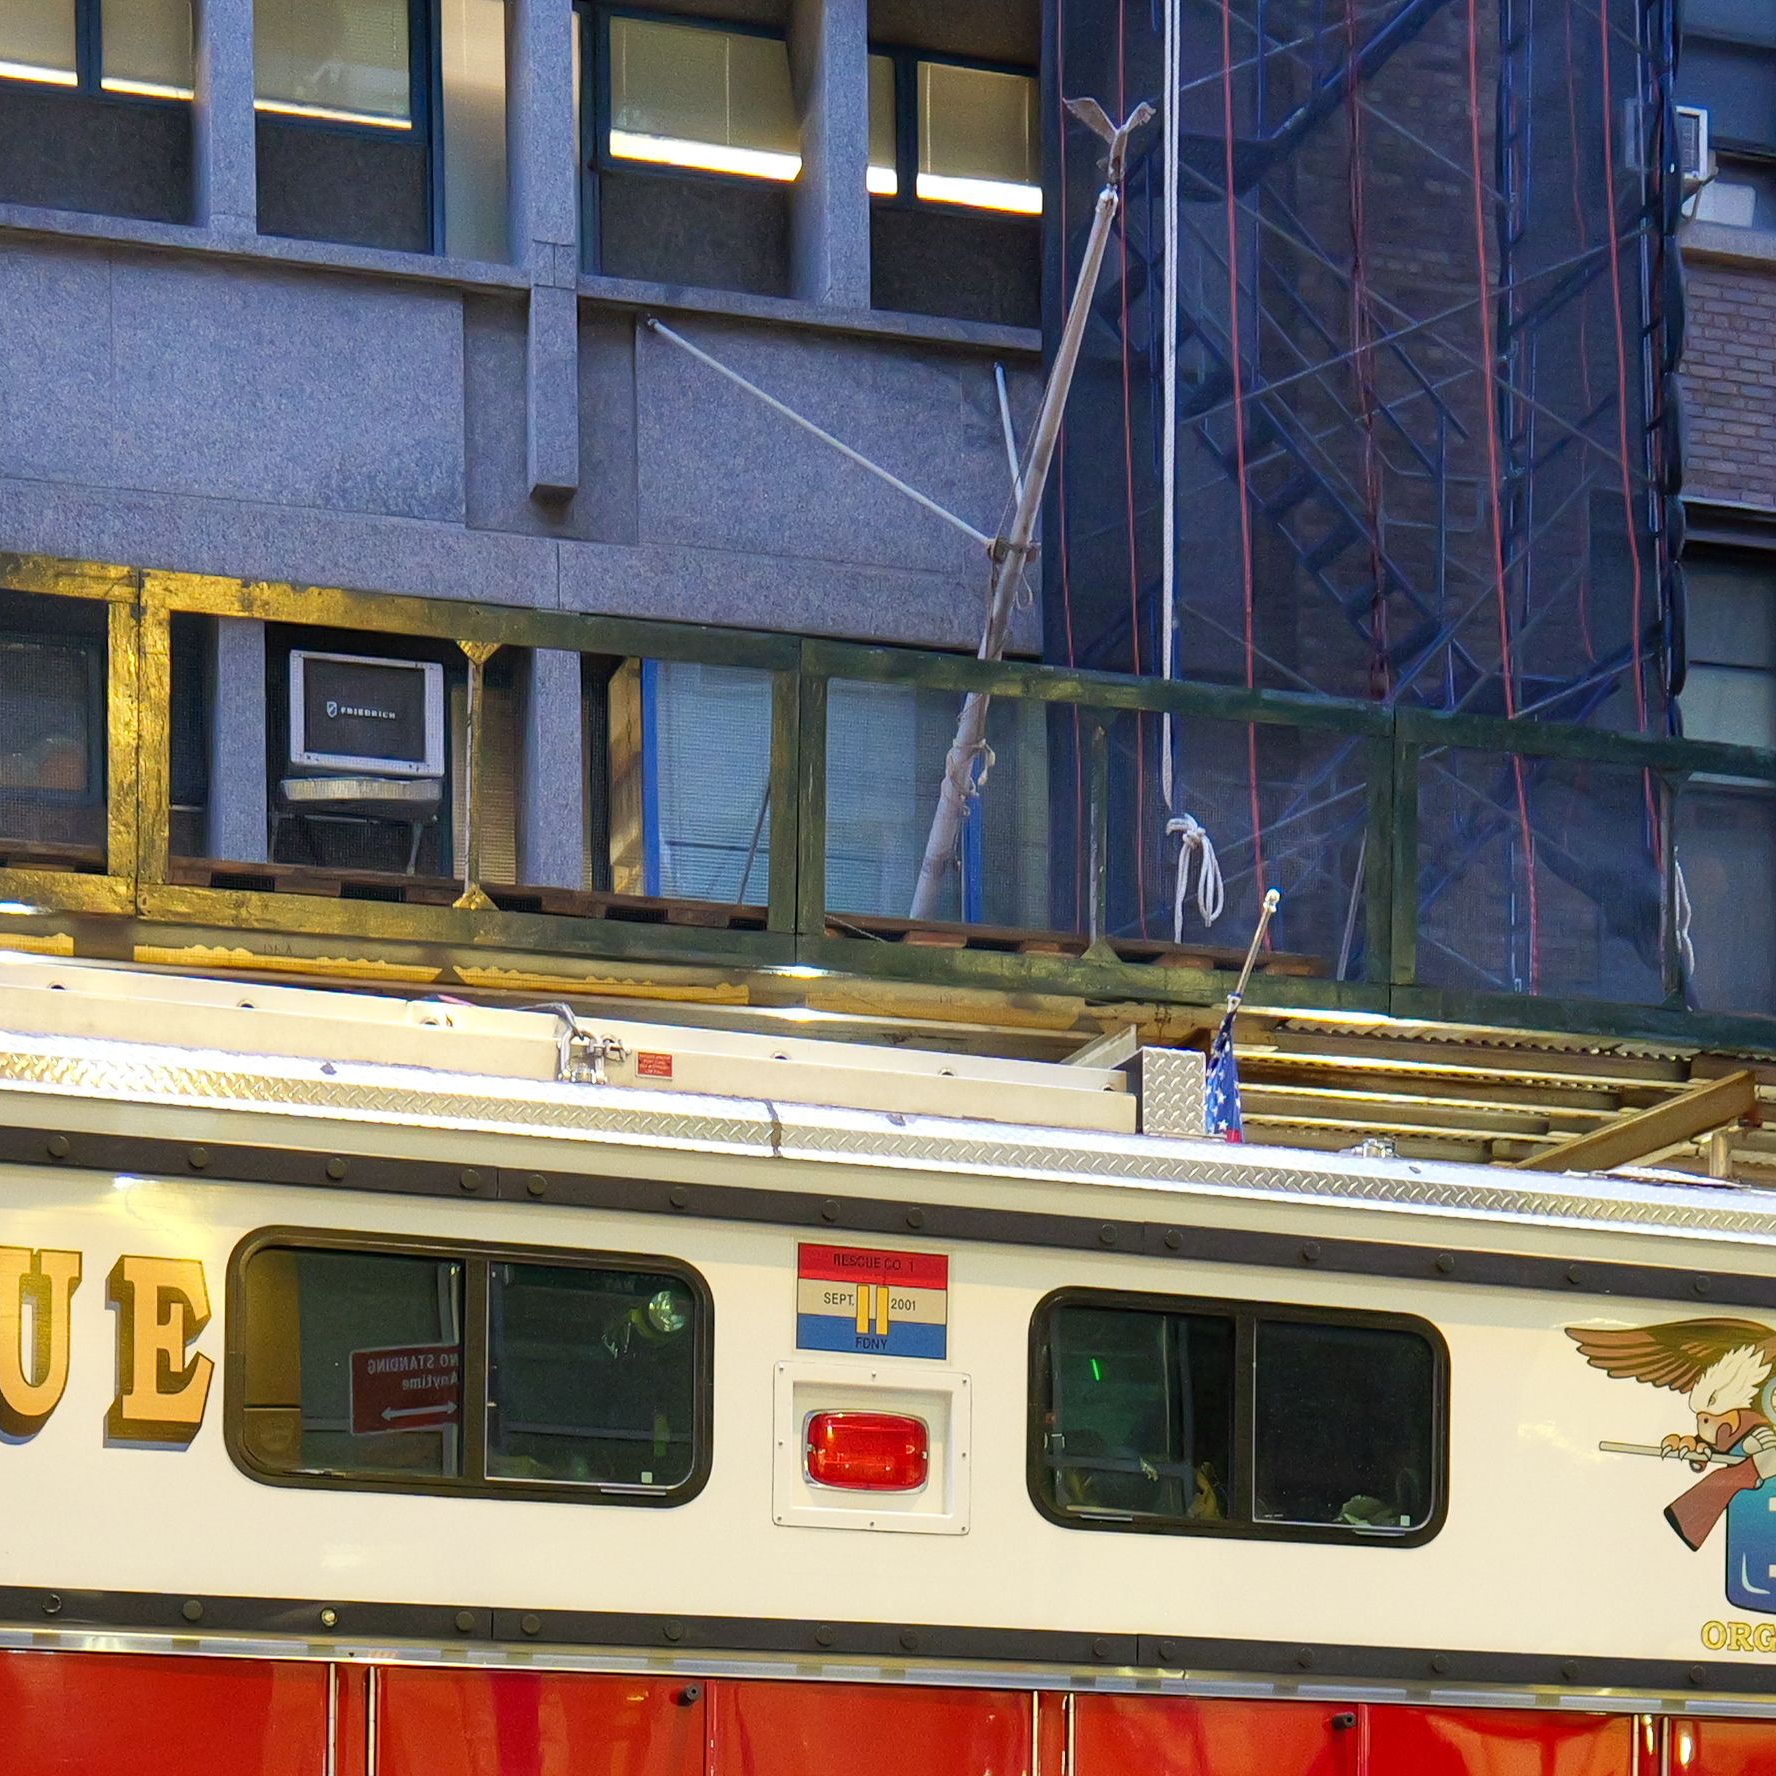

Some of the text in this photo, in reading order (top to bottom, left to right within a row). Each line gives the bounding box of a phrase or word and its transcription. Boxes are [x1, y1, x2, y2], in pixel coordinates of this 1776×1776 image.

[340, 706, 396, 719] FRIEDRICH
[834, 1253, 881, 1269] RESCUE
[823, 1291, 855, 1307] SEPT.
[890, 1298, 917, 1312] 2001
[855, 1336, 888, 1351] FDNY
